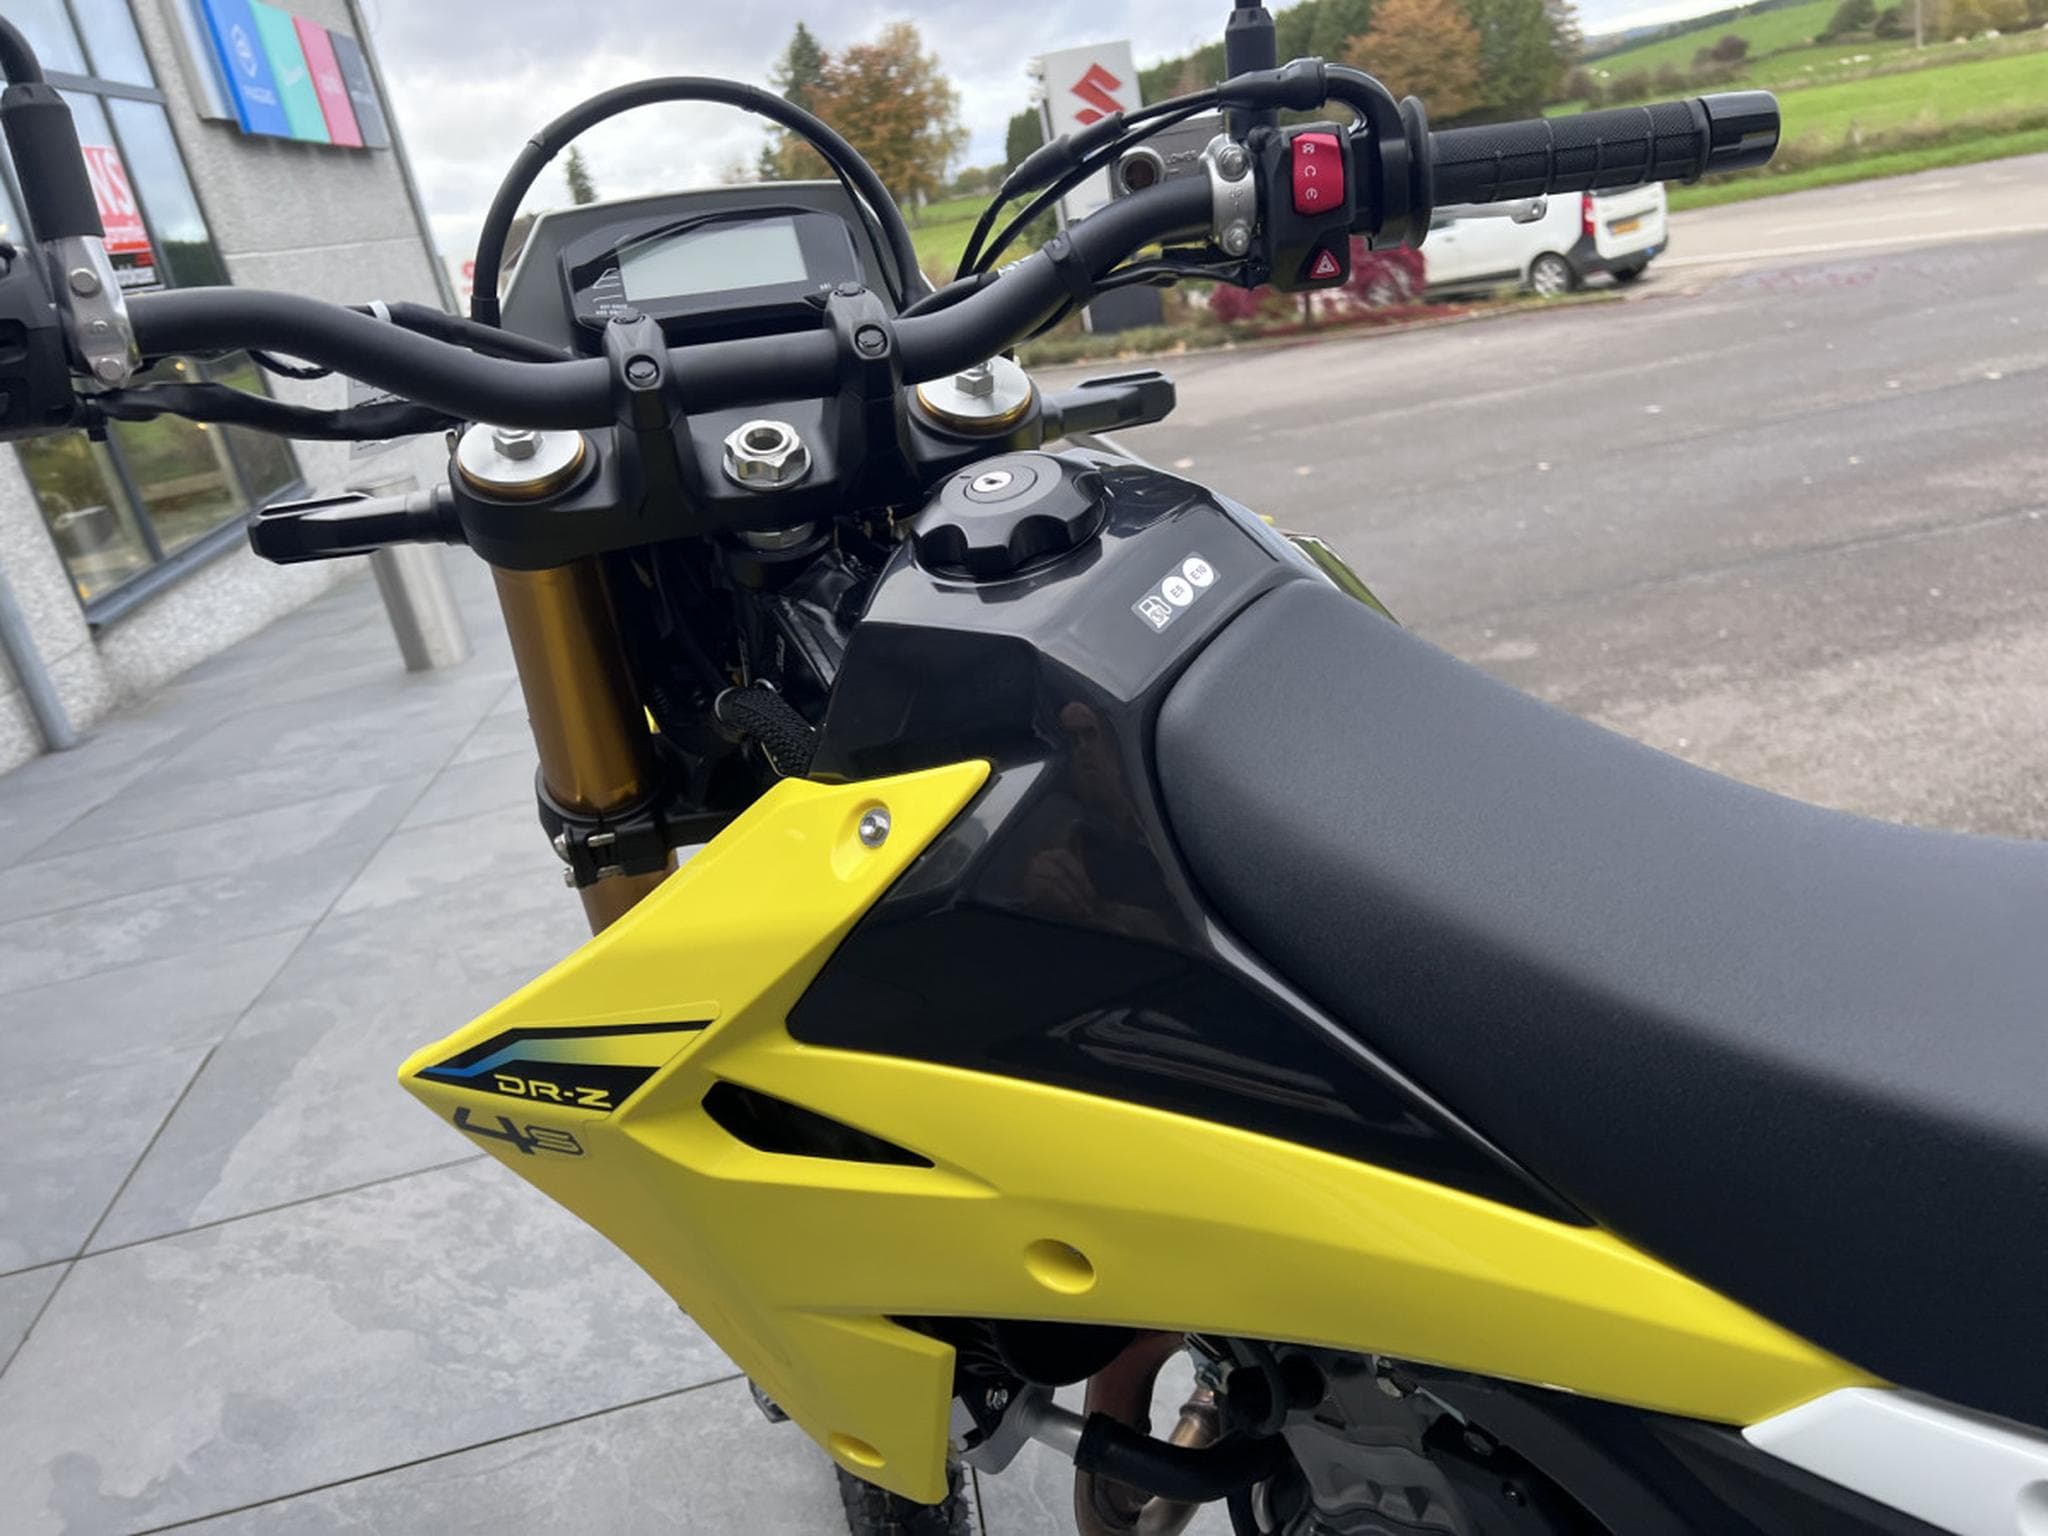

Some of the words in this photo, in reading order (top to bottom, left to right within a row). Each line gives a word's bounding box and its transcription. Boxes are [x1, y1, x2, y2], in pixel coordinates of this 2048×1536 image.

[1190, 564, 1207, 580] E10
[1170, 585, 1184, 598] E5
[494, 1074, 614, 1109] DR-Z
[453, 1106, 584, 1155] 4S
